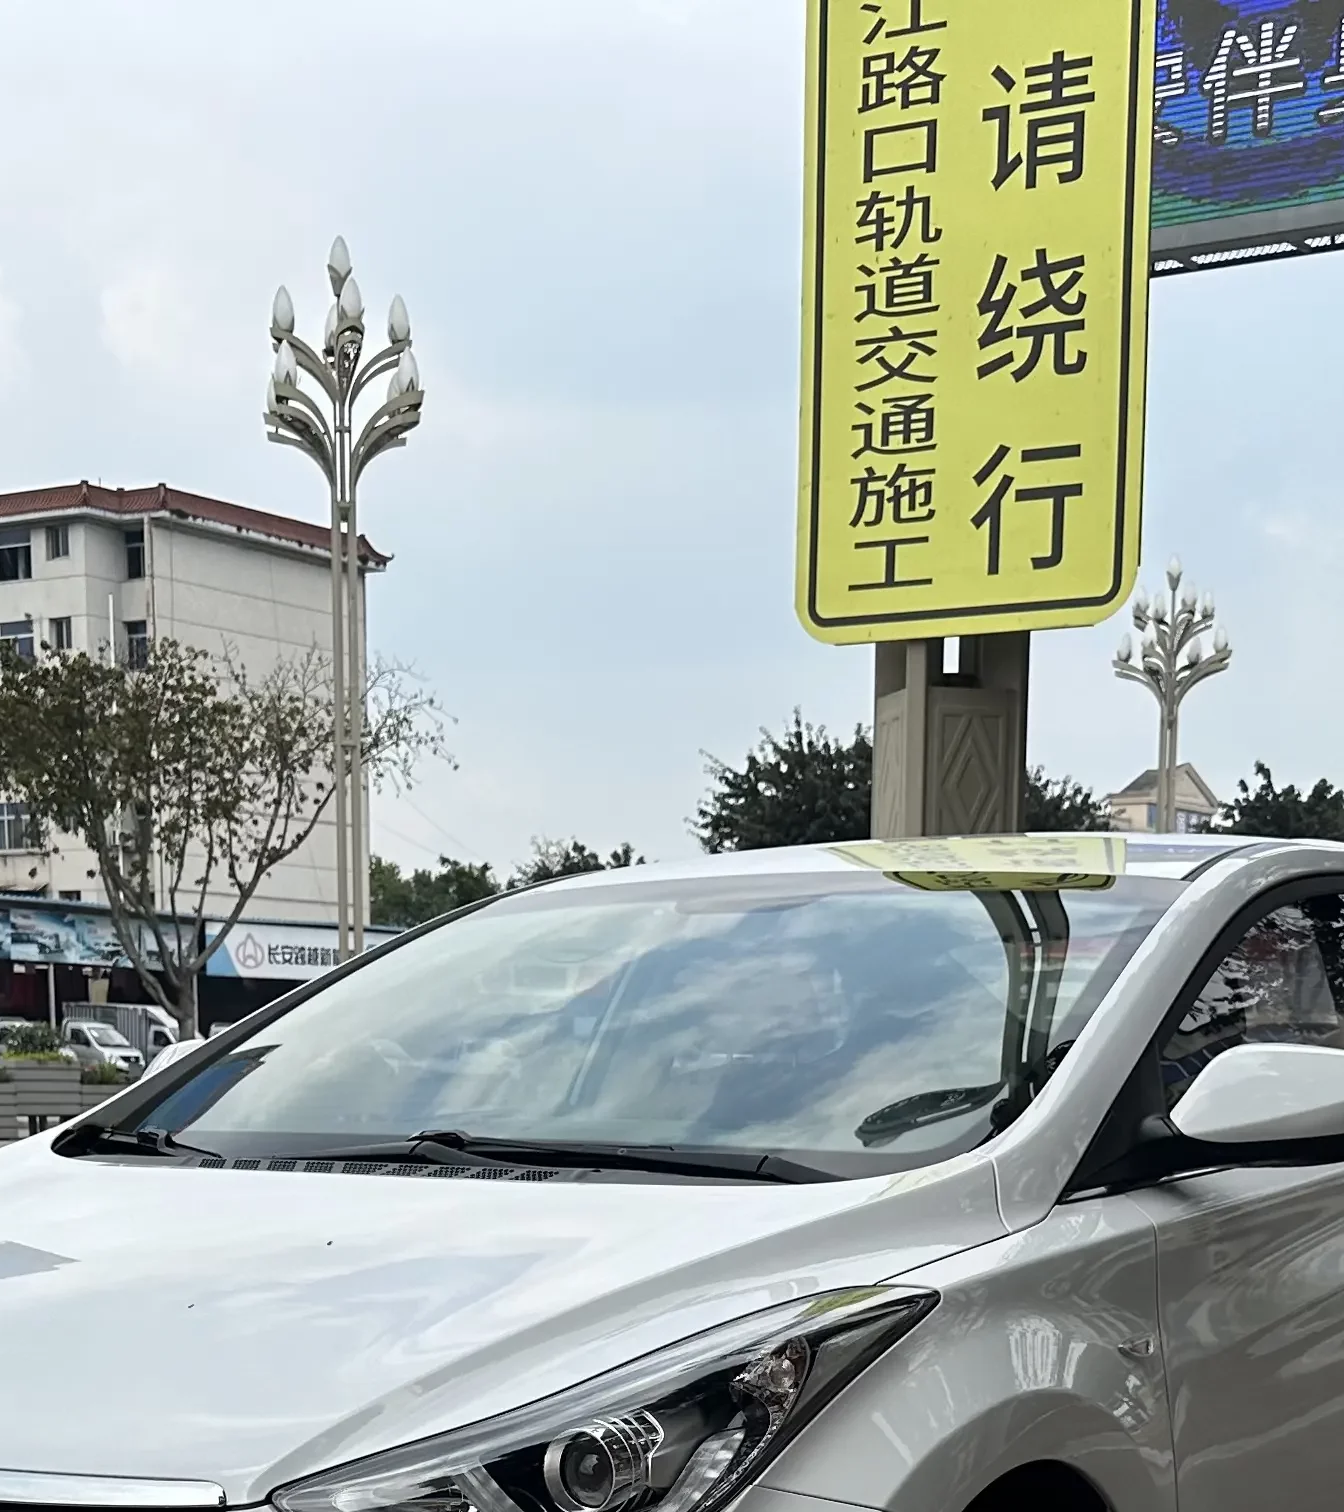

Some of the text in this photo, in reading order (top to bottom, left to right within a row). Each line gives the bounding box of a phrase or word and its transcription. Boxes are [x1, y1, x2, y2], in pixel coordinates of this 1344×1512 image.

[848, 0, 948, 592] 江路口轨道交通施工
[970, 50, 1096, 576] 请绕行
